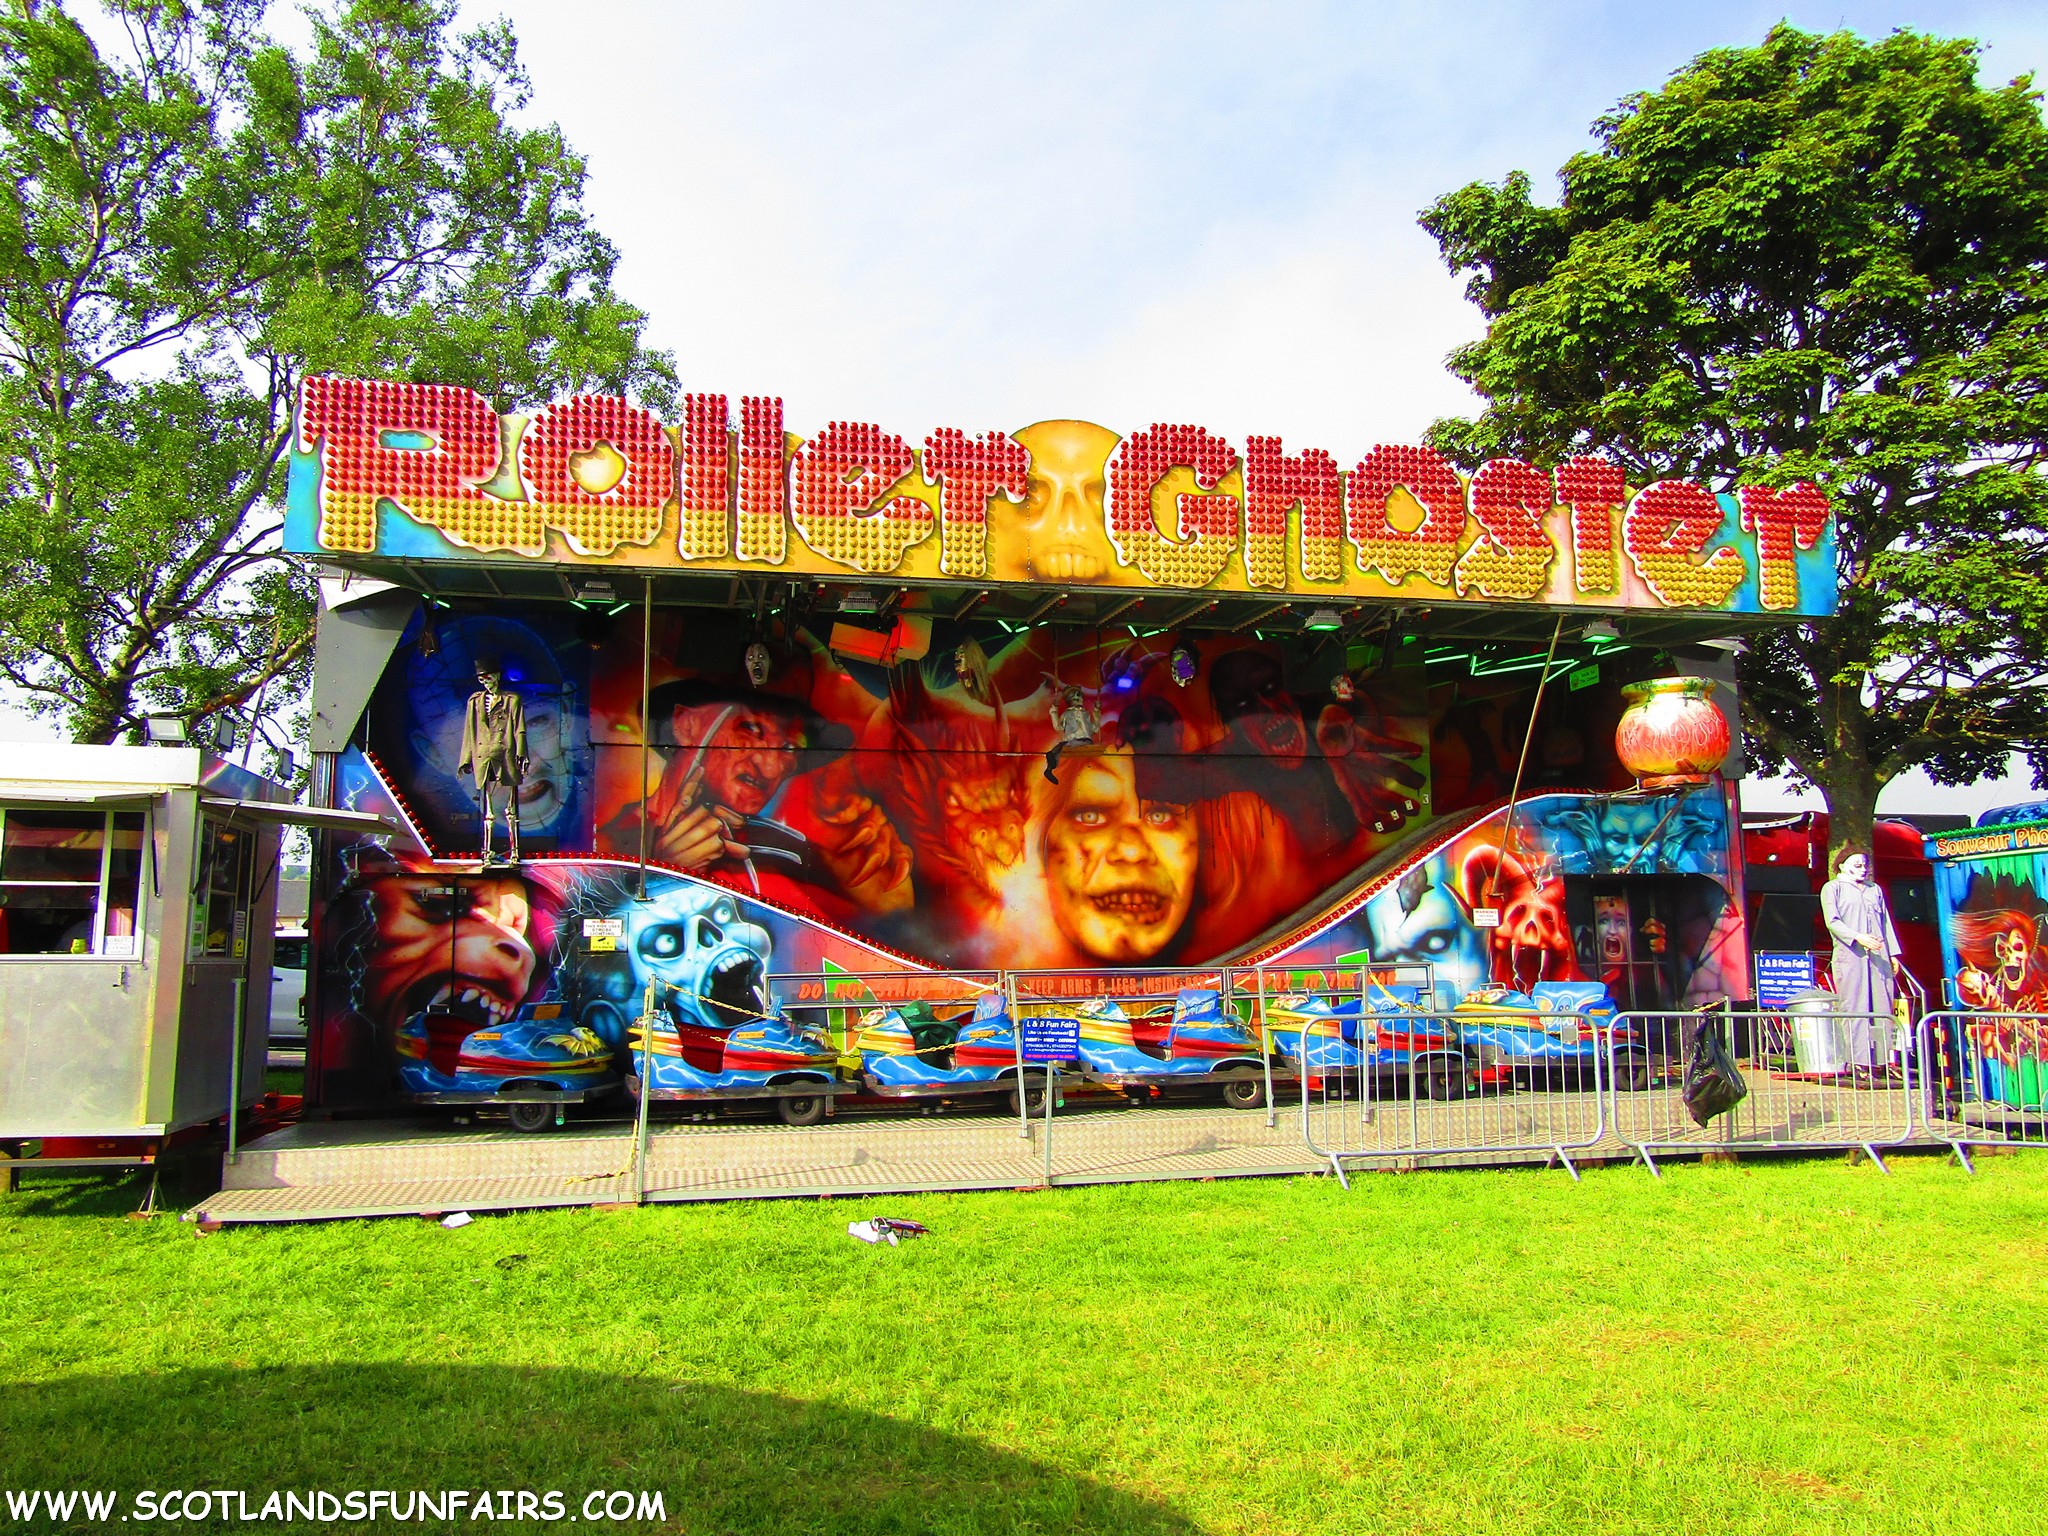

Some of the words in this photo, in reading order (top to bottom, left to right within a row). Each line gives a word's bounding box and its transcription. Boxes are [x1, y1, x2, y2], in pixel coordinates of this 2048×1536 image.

[298, 374, 1030, 577] Roller
[1103, 422, 1830, 610] Ghoster
[1936, 833, 2012, 856] Souvenir
[1759, 959, 1764, 967] L
[1765, 959, 1771, 967] &
[1772, 959, 1778, 967] B
[1778, 959, 1792, 968] Fun
[1792, 959, 1810, 968] Fairs
[798, 982, 823, 999] DO
[833, 981, 867, 999] NOT
[876, 980, 930, 998] STAND
[1028, 978, 1054, 995] KEEP
[1060, 977, 1092, 995] ARMS
[1098, 978, 1106, 995] &
[1111, 977, 1137, 994] LEGS
[1142, 975, 1180, 993] INSIDE
[1304, 973, 1321, 989] IN
[1330, 972, 1355, 989] THE
[1026, 1020, 1031, 1028] L
[1032, 1020, 1038, 1028] &
[1046, 1020, 1059, 1028] Fun
